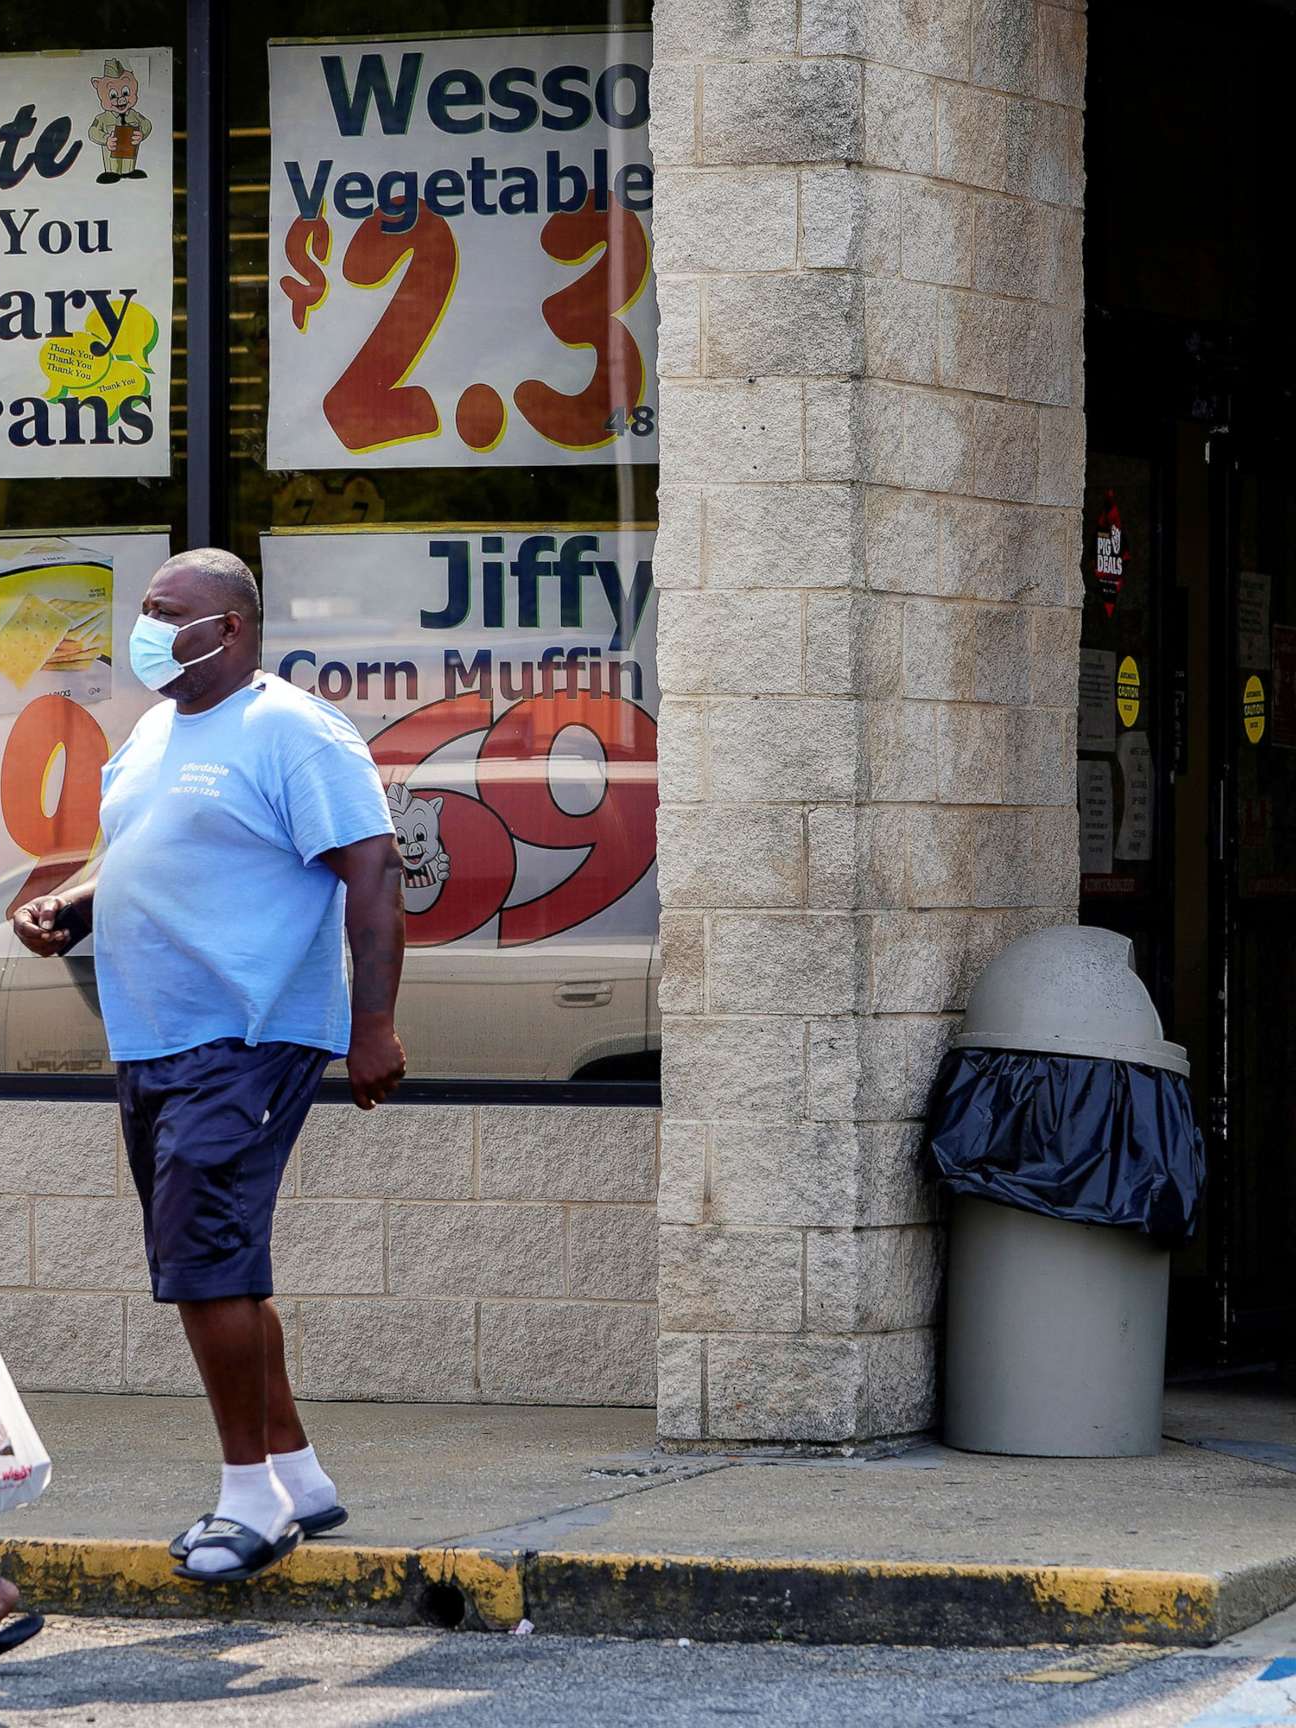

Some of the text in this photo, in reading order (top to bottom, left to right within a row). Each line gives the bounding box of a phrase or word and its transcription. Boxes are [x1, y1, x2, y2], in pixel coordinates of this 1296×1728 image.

[320, 52, 651, 137] Wesso
[283, 149, 655, 235] Vegetable
[47, 353, 92, 370] Thank You
[49, 343, 94, 360] Thank You
[47, 363, 92, 380] Thank You
[97, 378, 136, 393] Thank You
[603, 405, 655, 437] 48
[1097, 537, 1112, 556] PIG
[1097, 555, 1123, 576] DEALS
[420, 535, 654, 652] Jiffy
[279, 646, 644, 701] Corn Muffin
